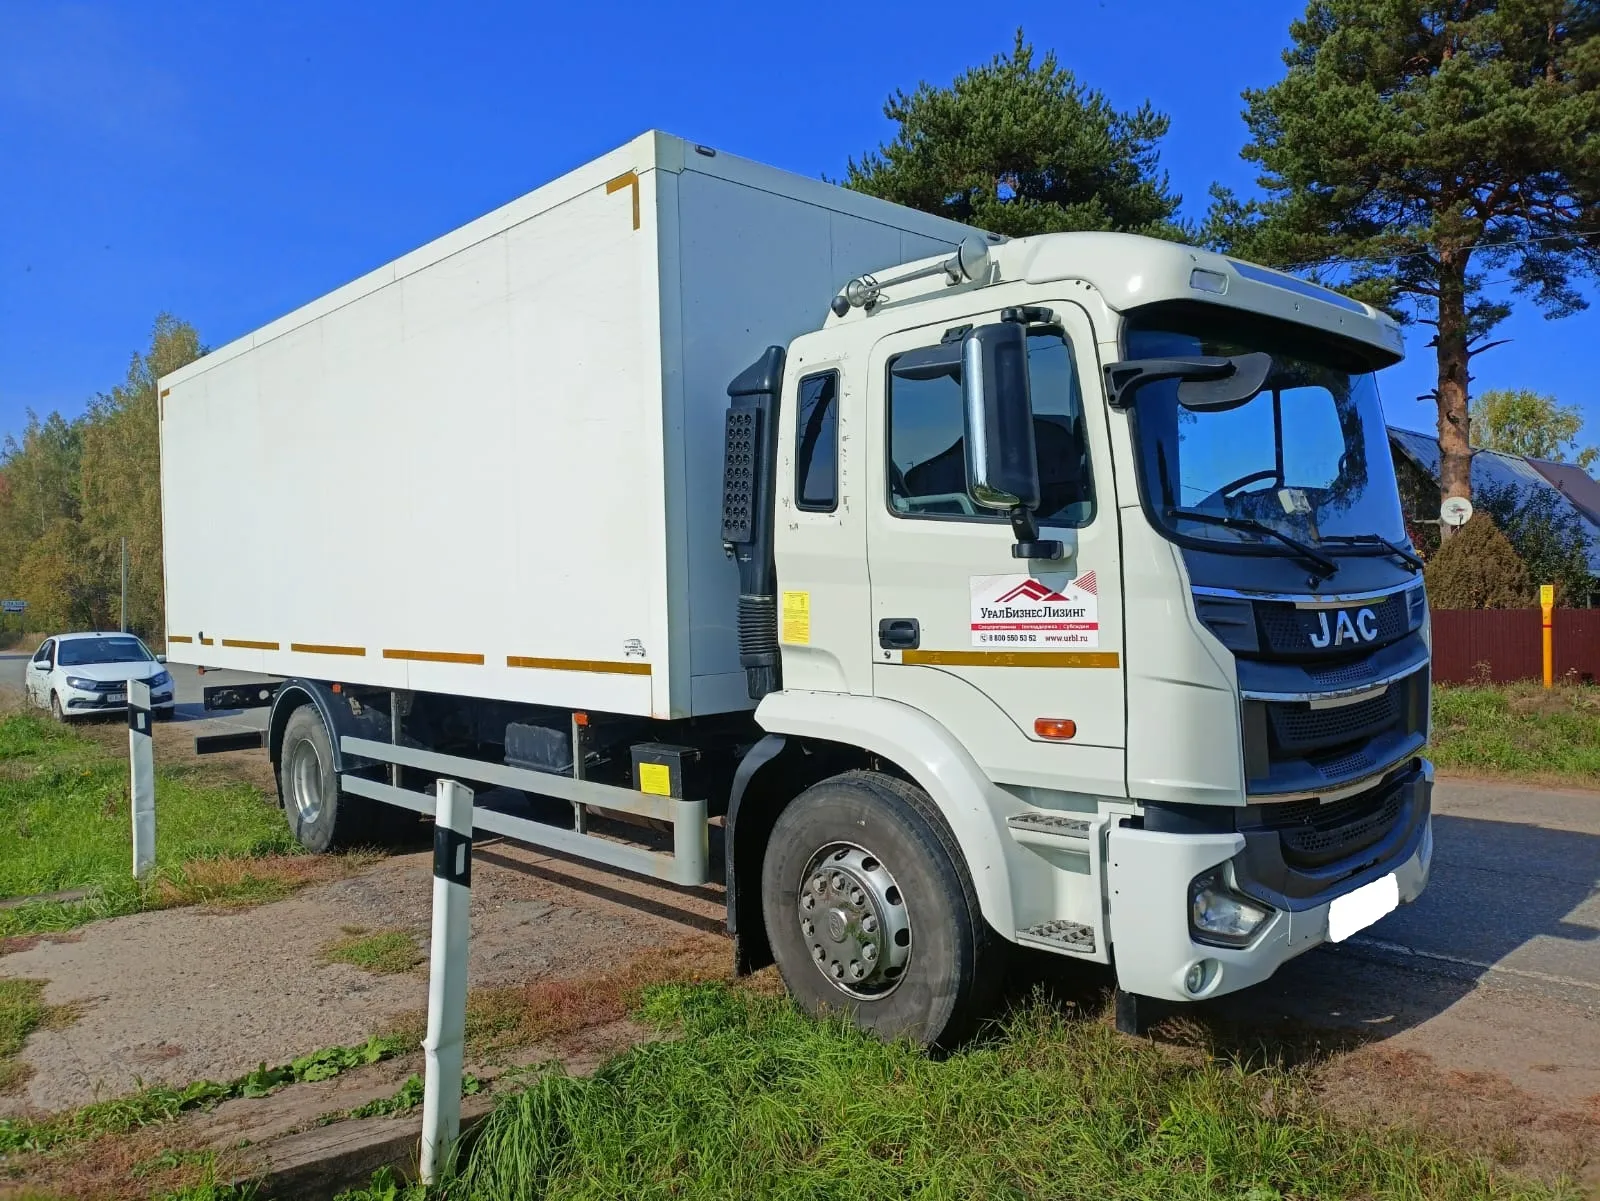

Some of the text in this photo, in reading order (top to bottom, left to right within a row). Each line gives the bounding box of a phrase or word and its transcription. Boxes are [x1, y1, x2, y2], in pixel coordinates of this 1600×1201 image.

[1308, 608, 1378, 648] JAC
[994, 634, 1006, 642] 800
[1007, 634, 1019, 642] 550
[1028, 634, 1037, 642] 52
[1045, 634, 1088, 642] www.urbl.ru
